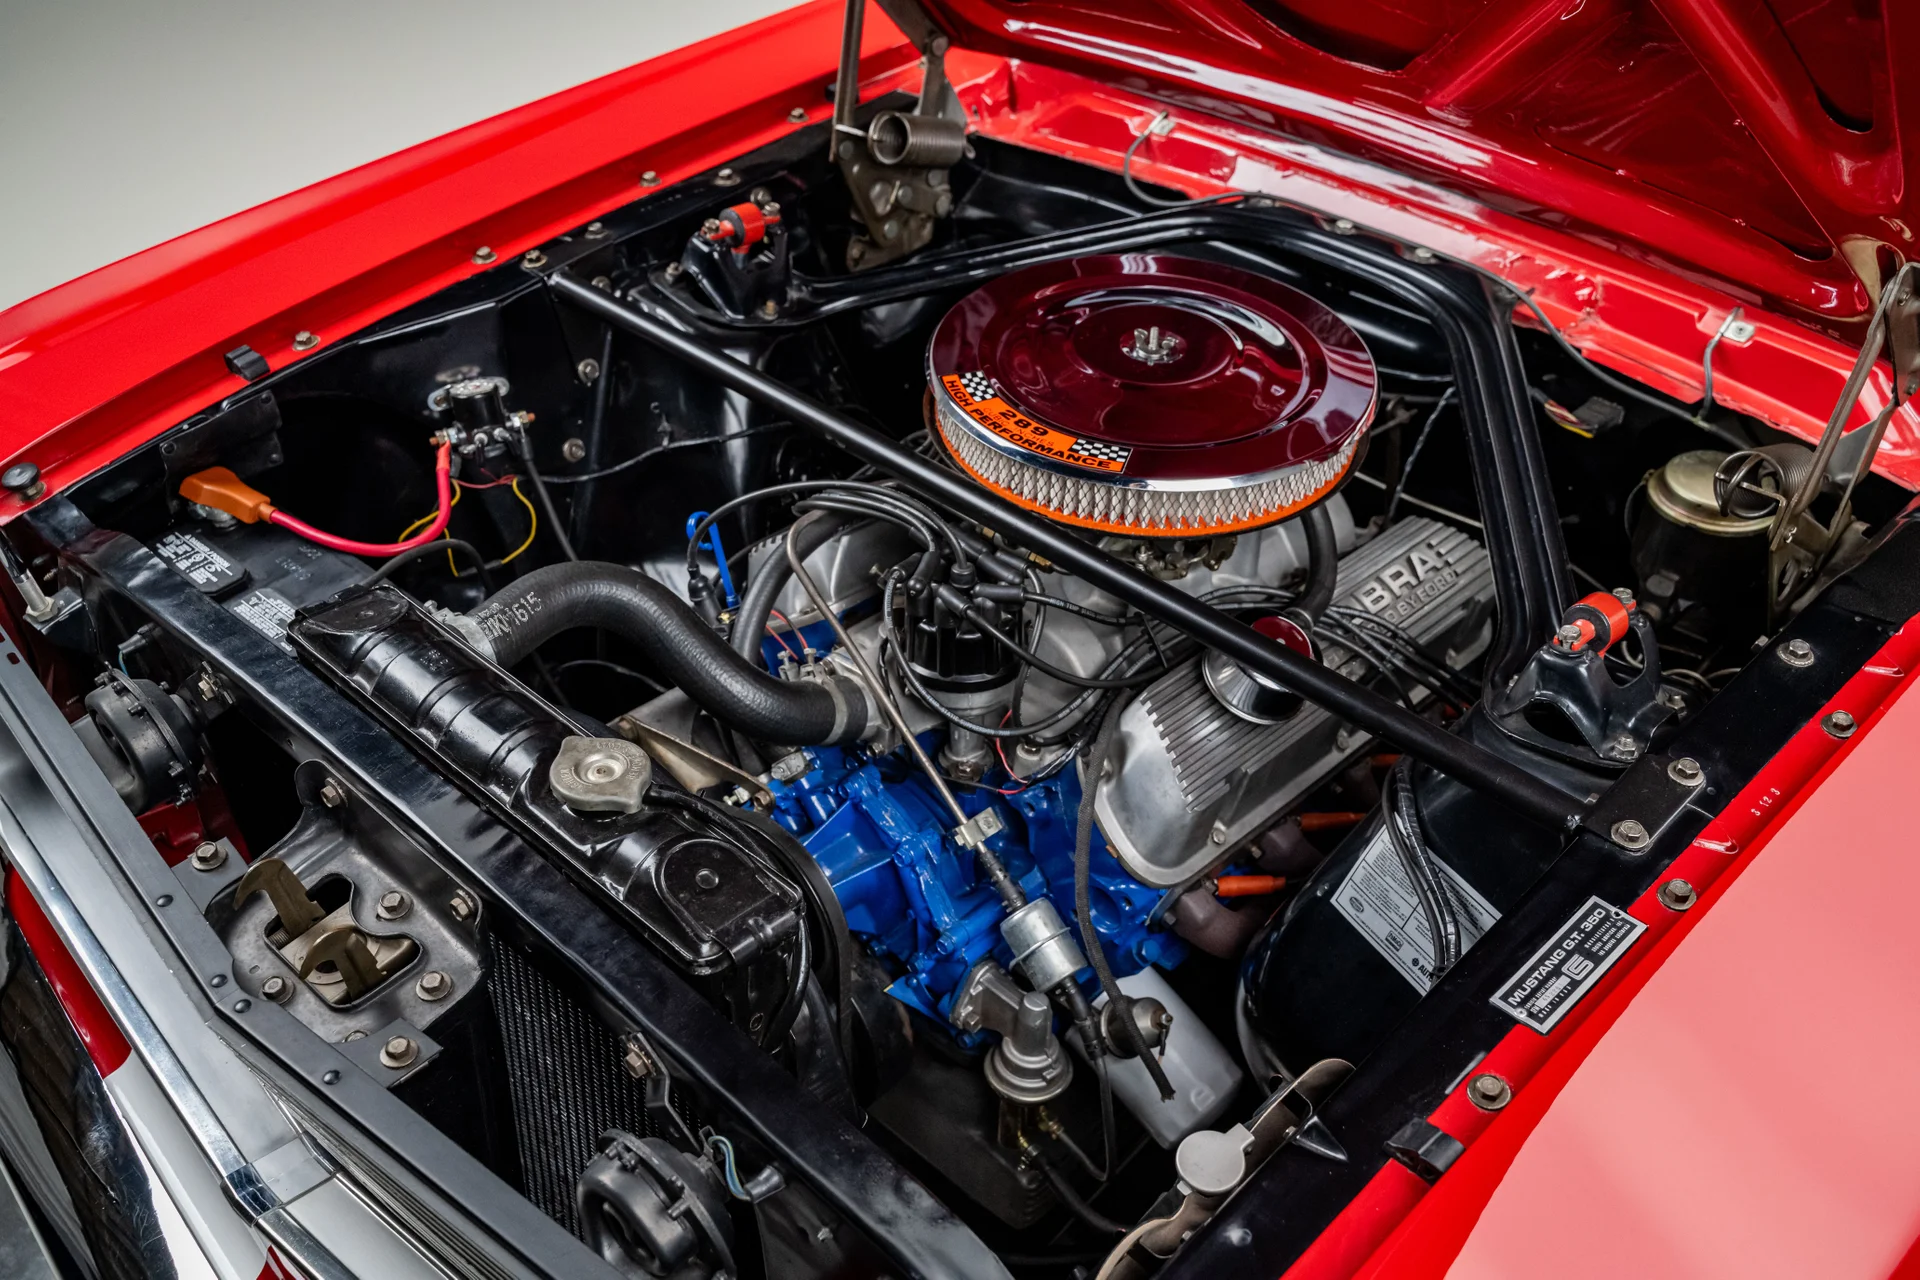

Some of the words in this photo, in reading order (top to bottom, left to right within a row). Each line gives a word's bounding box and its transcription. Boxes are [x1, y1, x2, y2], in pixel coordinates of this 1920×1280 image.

[945, 380, 975, 407] HIGH
[970, 408, 1111, 469] PERFORMANCE
[984, 407, 1010, 427] CUBIC
[1013, 427, 1056, 447] INCHES
[998, 409, 1049, 437] 289
[1355, 551, 1445, 614] BRA
[1397, 593, 1418, 615] BY
[1416, 568, 1456, 600] FORD
[1507, 950, 1567, 1006] MUSTANG
[1562, 931, 1586, 951] G.T.
[1580, 908, 1606, 932] 350
